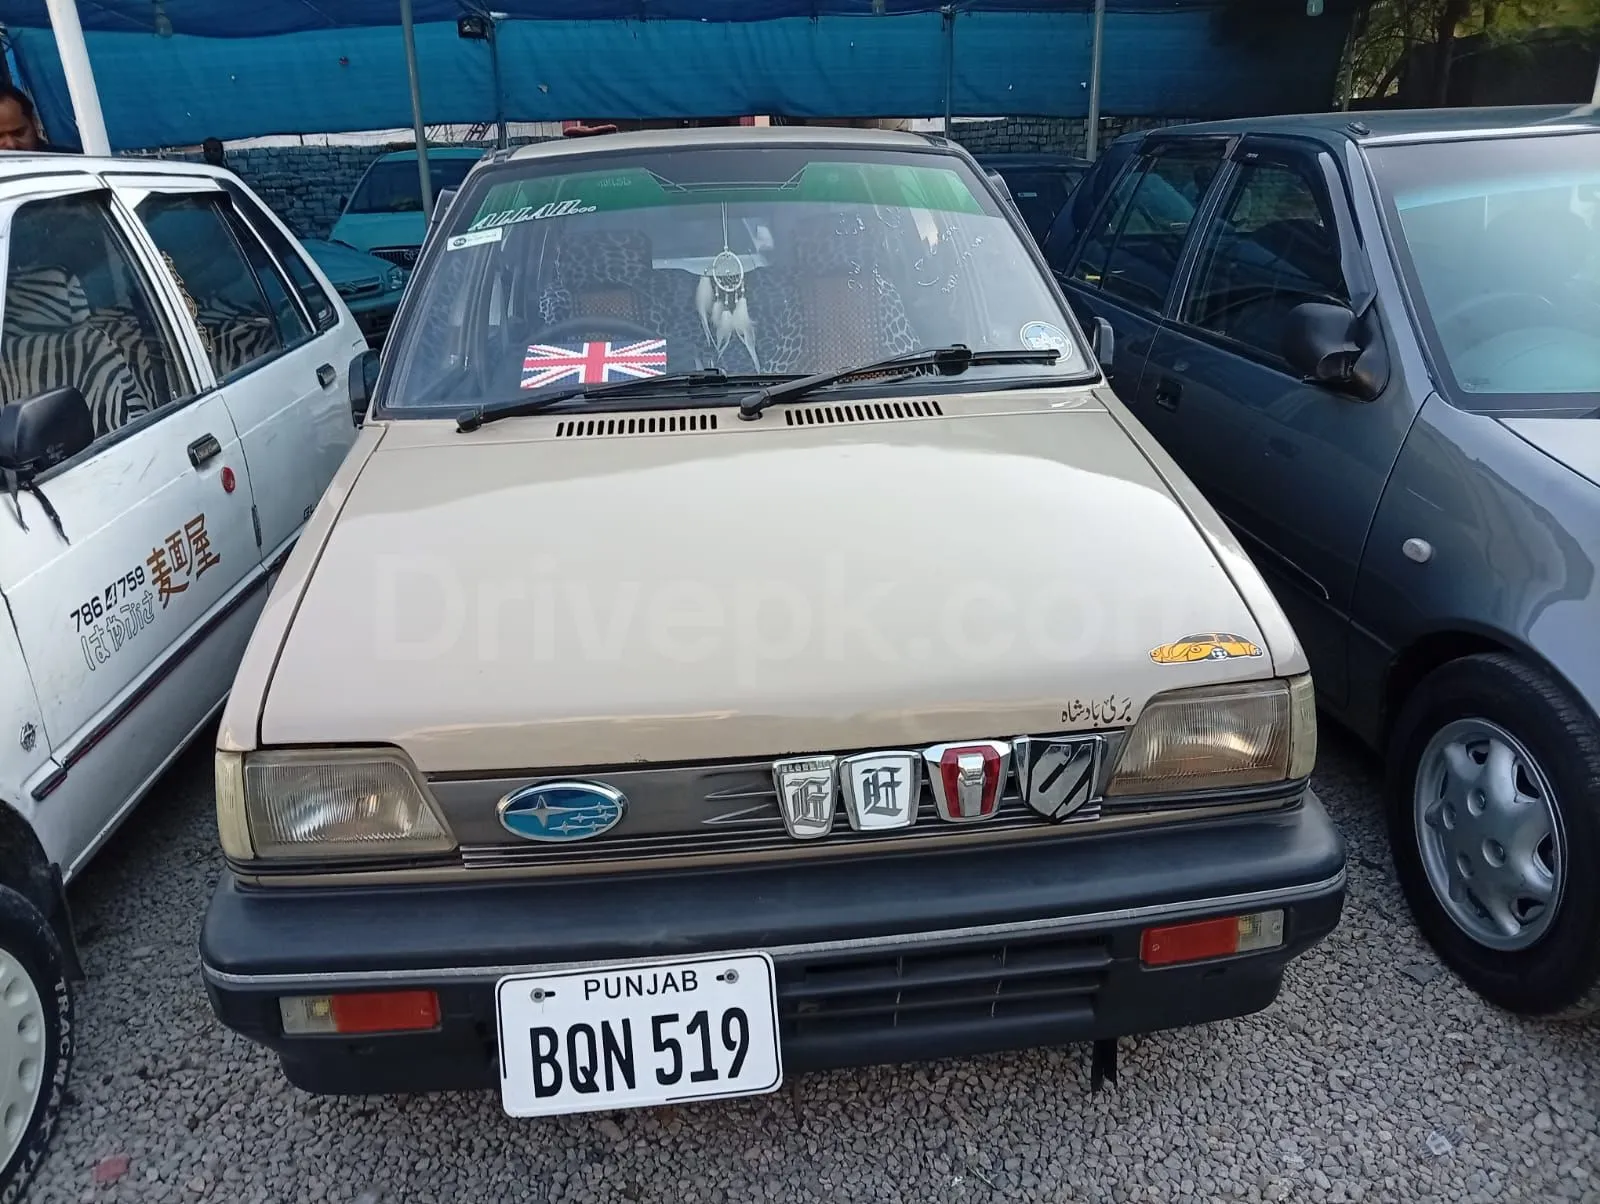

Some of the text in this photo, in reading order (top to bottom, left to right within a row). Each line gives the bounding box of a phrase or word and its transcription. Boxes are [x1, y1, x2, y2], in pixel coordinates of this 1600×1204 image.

[70, 596, 103, 633] 786
[117, 565, 146, 598] 759
[584, 970, 699, 1001] PUNJAB
[529, 1006, 750, 1098] BQN 519
